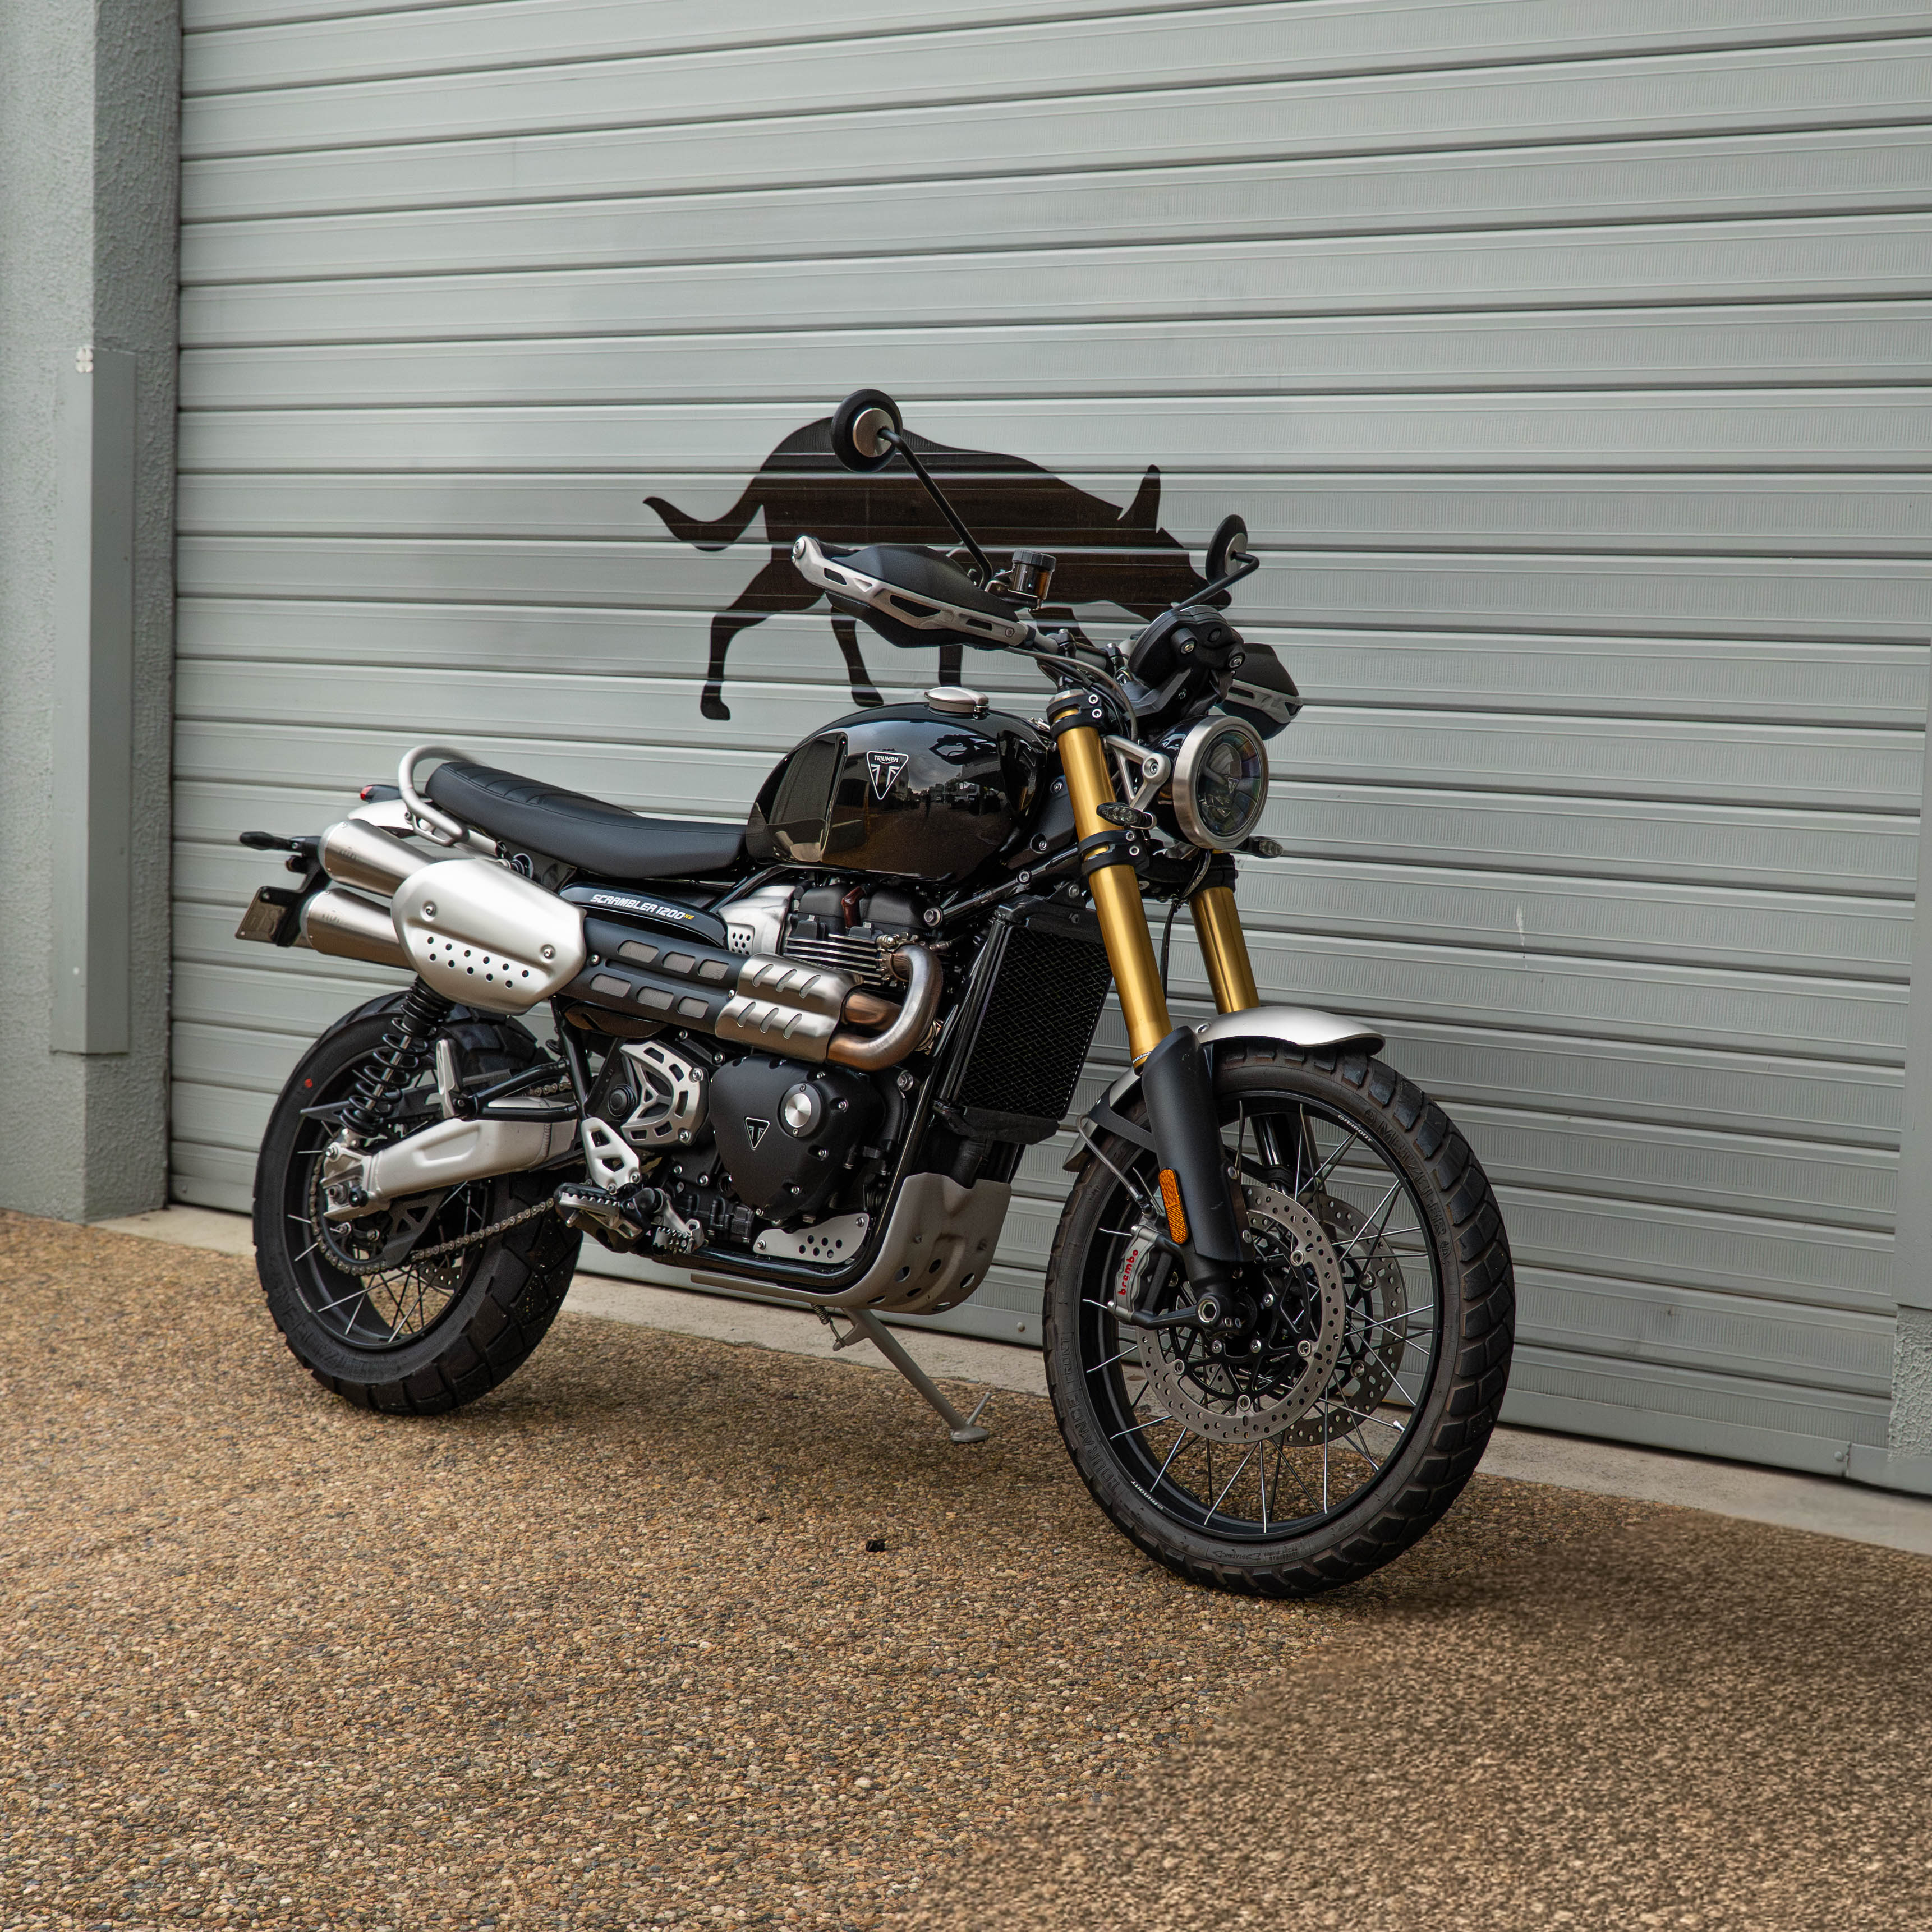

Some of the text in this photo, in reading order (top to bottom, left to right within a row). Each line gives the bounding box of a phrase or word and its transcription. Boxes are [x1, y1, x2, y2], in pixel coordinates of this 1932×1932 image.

[874, 755, 899, 763] TRIUMPH
[590, 894, 658, 913] SCRAMBLER
[1117, 1249, 1138, 1295] brembo
